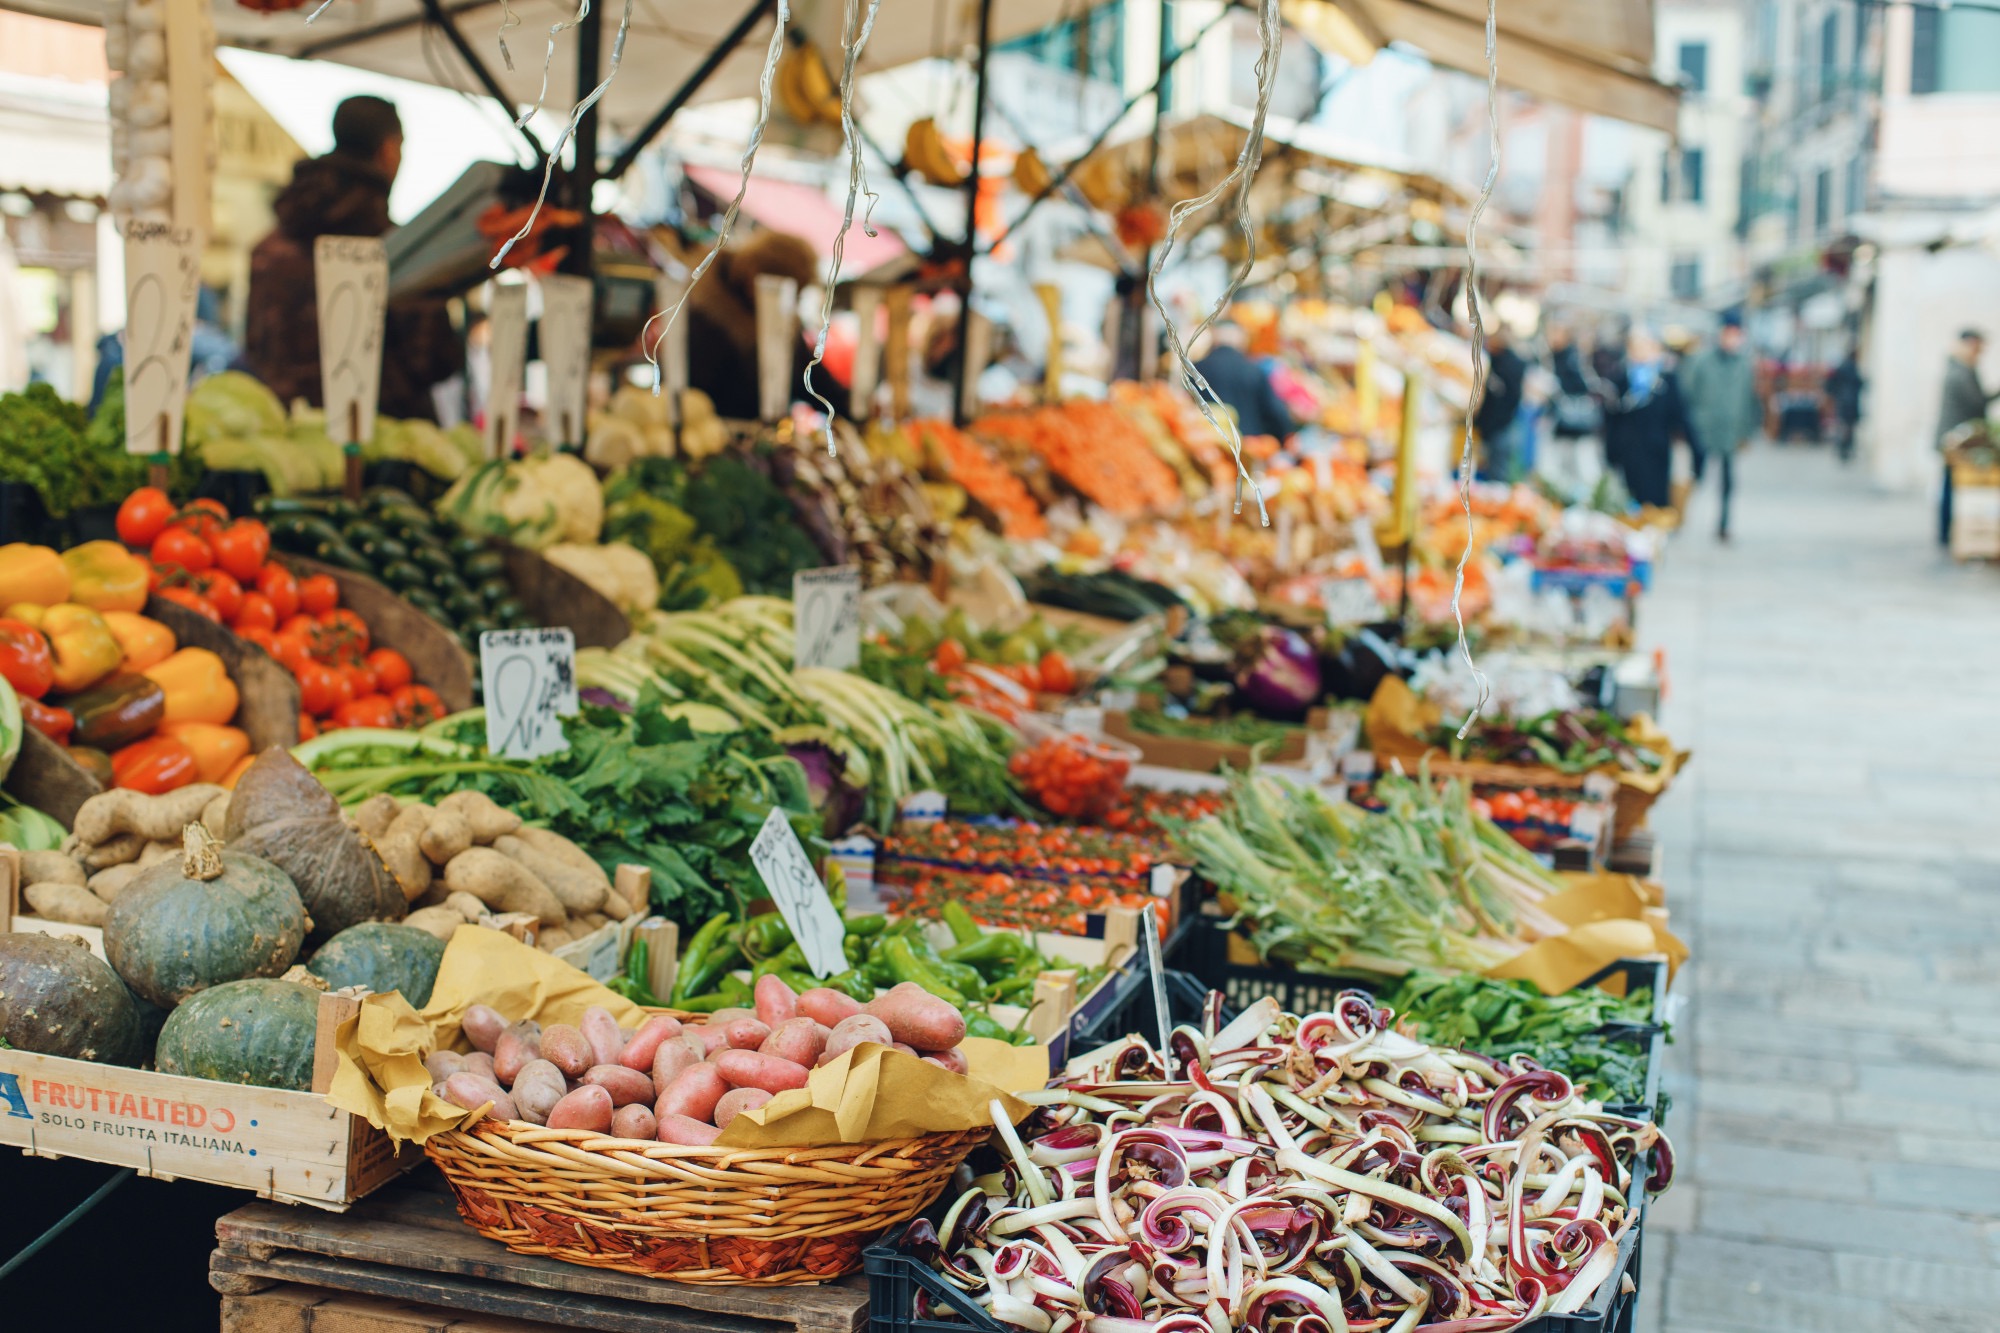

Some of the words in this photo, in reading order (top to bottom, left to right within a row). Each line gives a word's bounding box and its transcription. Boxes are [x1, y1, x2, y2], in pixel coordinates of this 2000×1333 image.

[41, 1112, 85, 1130] SOLO
[93, 1120, 157, 1142] FRUTTA
[164, 1131, 245, 1154] ITALIANA
